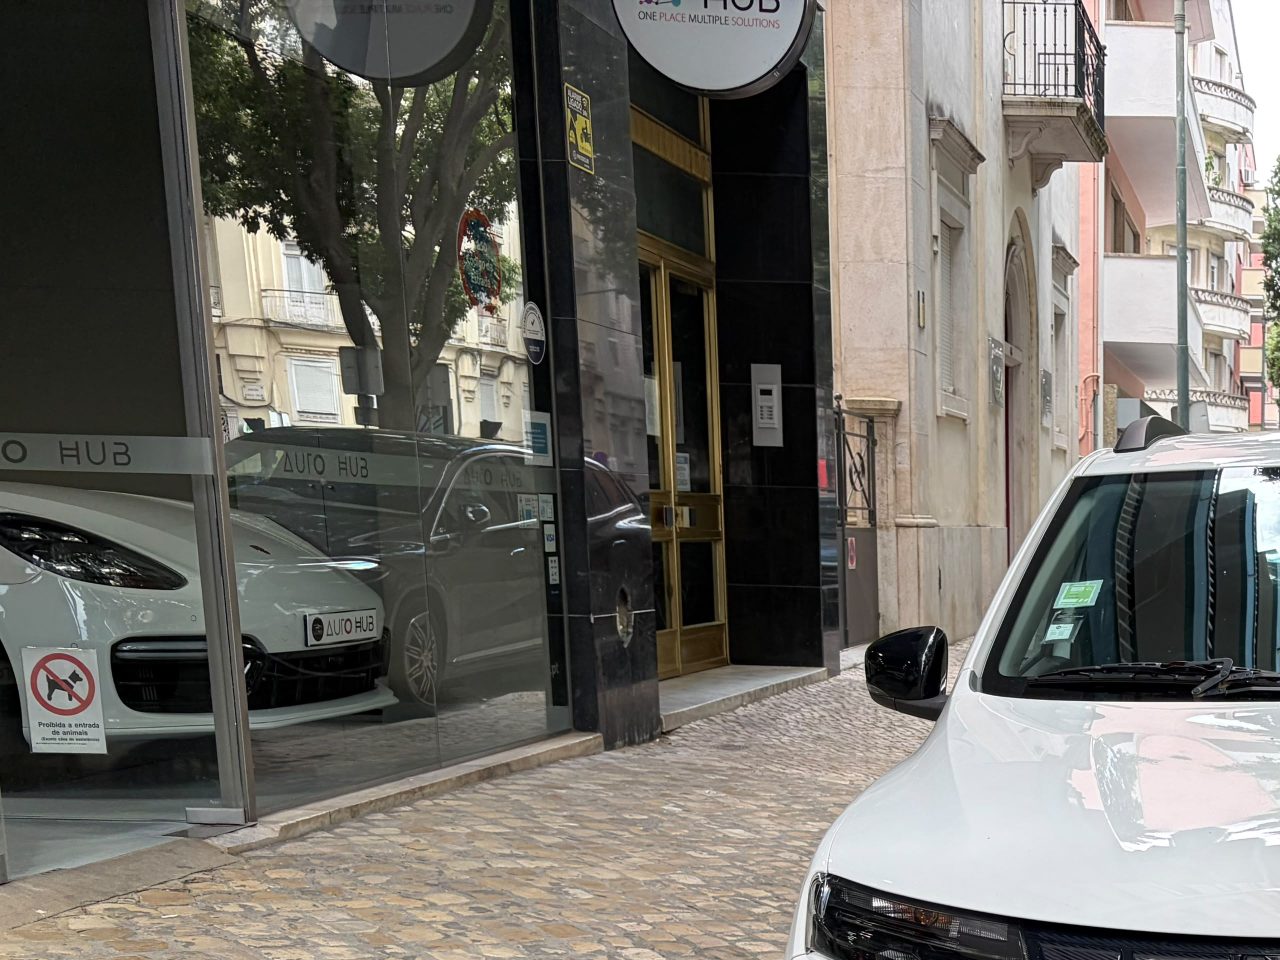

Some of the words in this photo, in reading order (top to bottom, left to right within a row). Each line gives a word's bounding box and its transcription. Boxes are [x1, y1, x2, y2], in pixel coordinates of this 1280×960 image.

[638, 10, 657, 21] ONE
[659, 12, 687, 23] PLACE
[688, 14, 730, 26] MULTIPLE
[731, 16, 781, 29] SOLUTIONS
[58, 440, 132, 466] HUB
[283, 453, 326, 476] AUTO
[337, 455, 369, 478] HUB
[326, 618, 353, 637] AUTO
[354, 615, 375, 634] HUB
